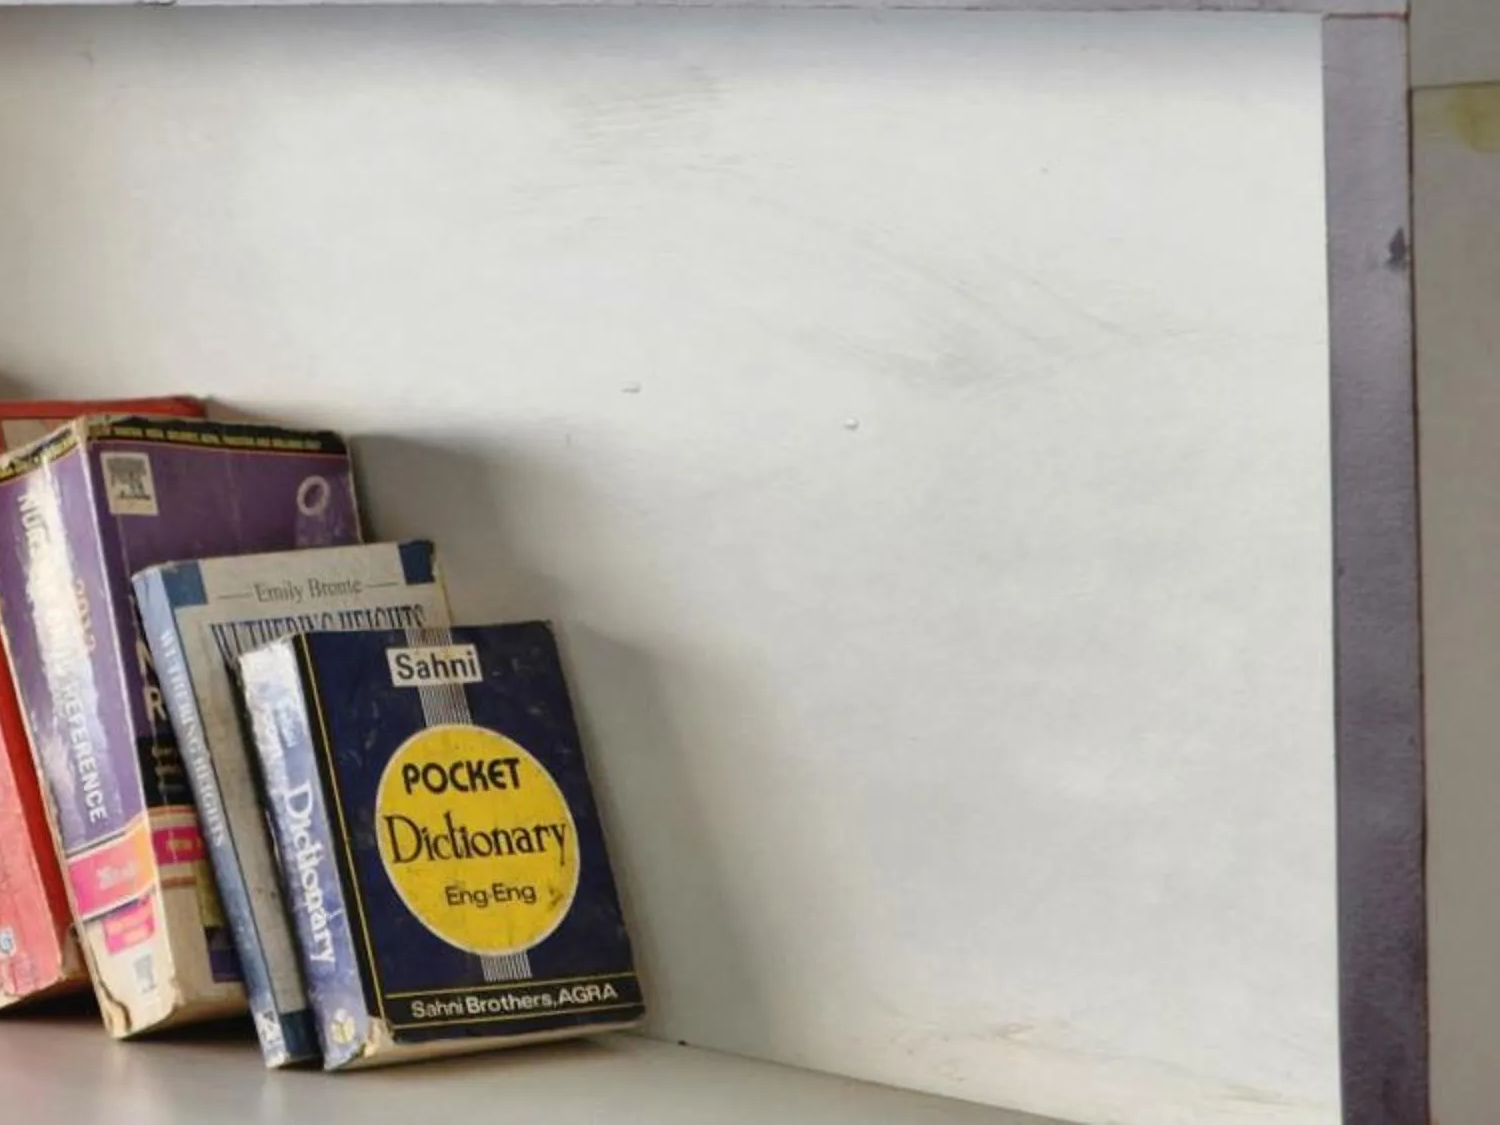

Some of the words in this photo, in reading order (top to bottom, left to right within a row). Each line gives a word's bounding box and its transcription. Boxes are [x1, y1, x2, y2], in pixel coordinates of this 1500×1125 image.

[253, 582, 304, 604] Emily
[393, 651, 477, 682] Sahni
[60, 681, 109, 825] REFERENCE
[159, 630, 202, 756] WUTHERING
[190, 755, 225, 847] HEIGHTS
[401, 757, 521, 796] POCKET
[382, 810, 569, 867] Dictionary
[282, 780, 336, 965] Dictionary
[410, 999, 464, 1020] Sahni
[557, 982, 619, 1007] AGRA
